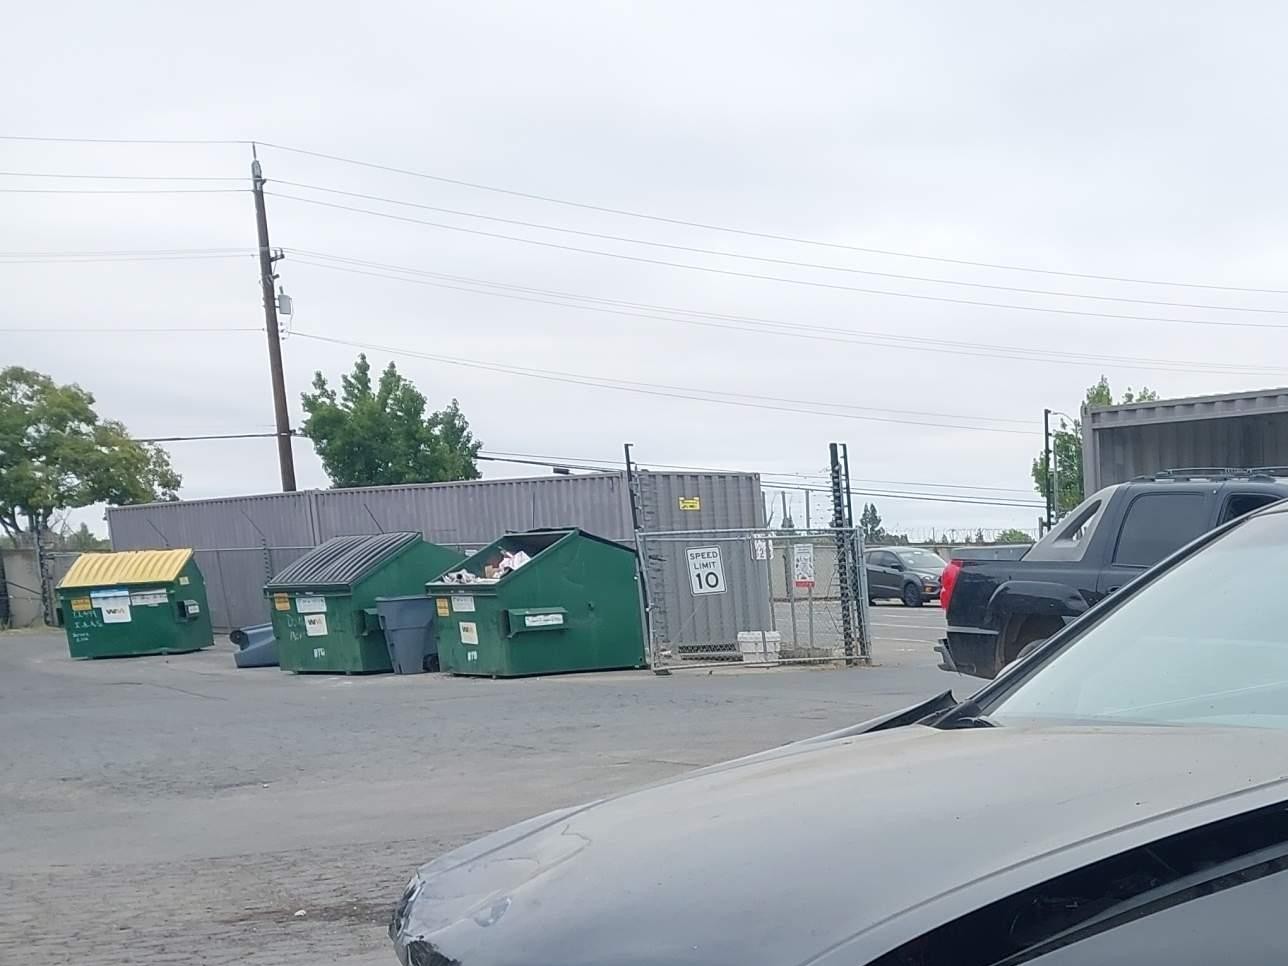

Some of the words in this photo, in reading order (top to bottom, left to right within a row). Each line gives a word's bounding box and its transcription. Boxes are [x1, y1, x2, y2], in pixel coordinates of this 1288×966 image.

[689, 551, 718, 560] SPEED
[693, 561, 717, 570] LIMIT
[696, 571, 719, 589] 10
